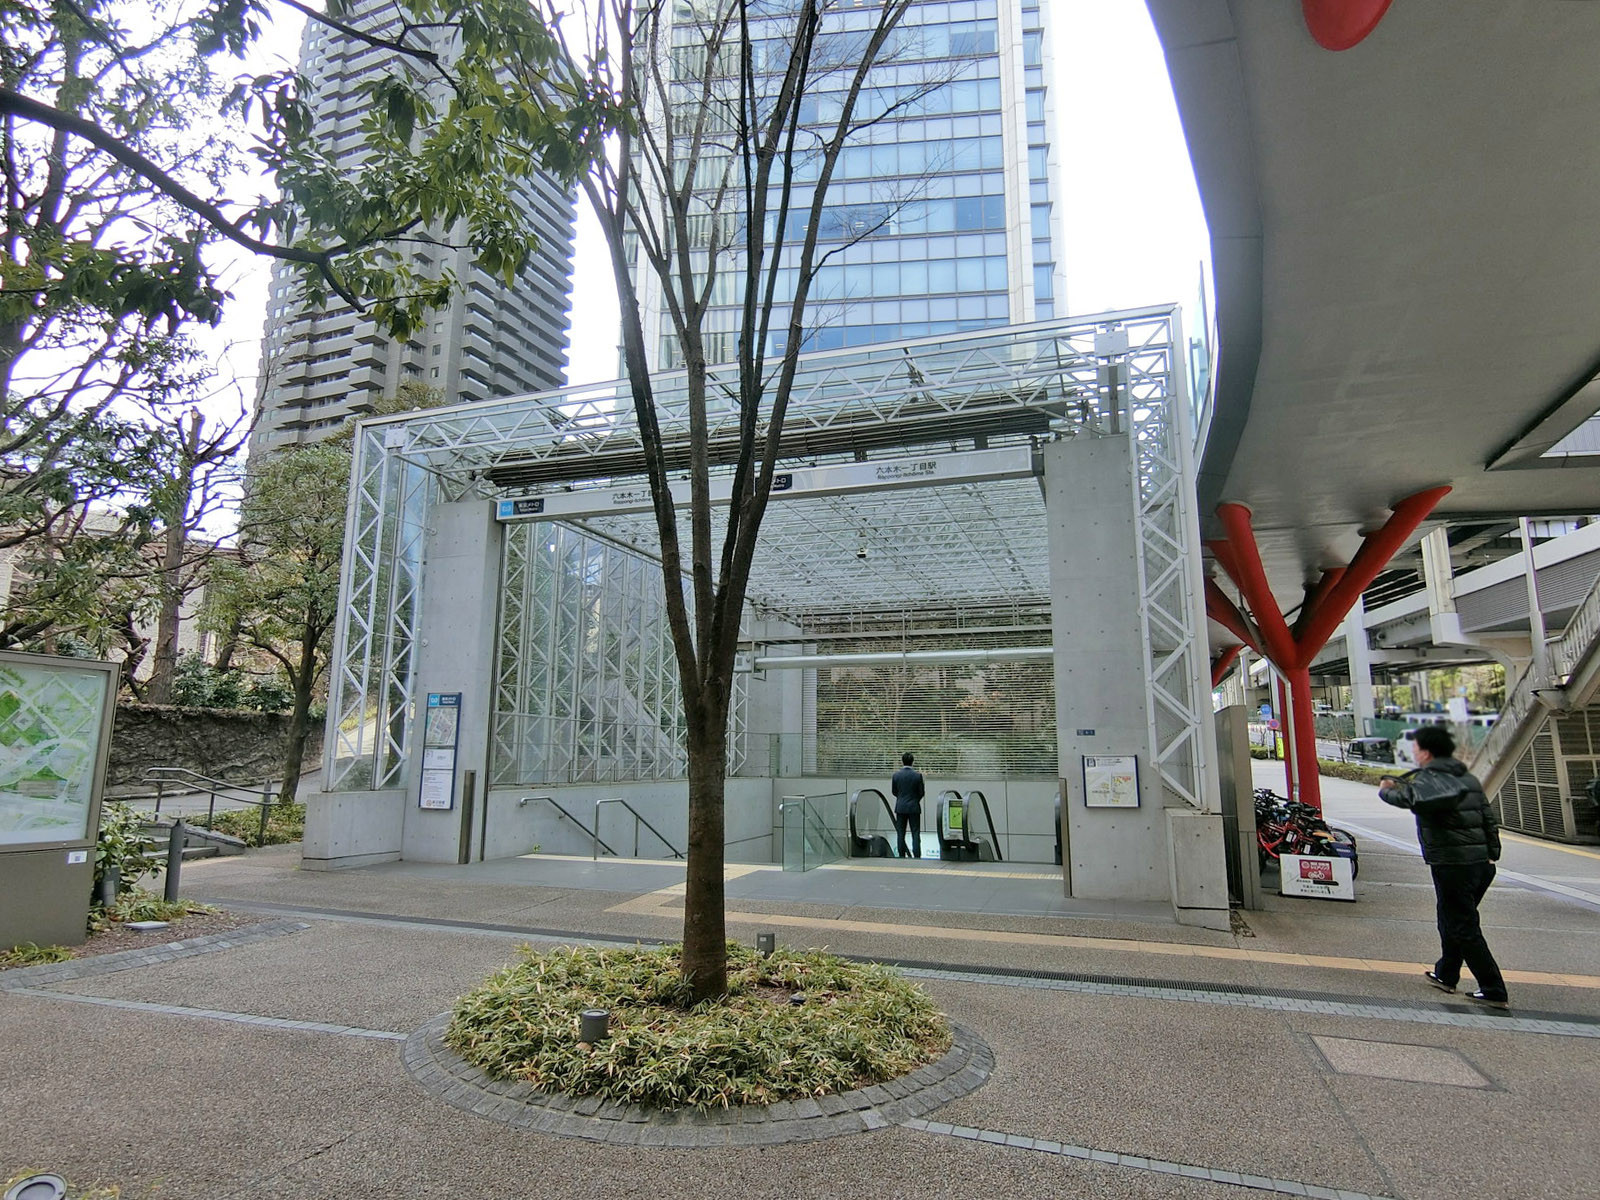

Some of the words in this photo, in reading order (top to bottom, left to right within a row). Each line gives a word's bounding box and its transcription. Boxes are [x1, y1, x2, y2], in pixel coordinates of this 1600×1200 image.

[876, 461, 937, 475] 六本木一丁目駅
